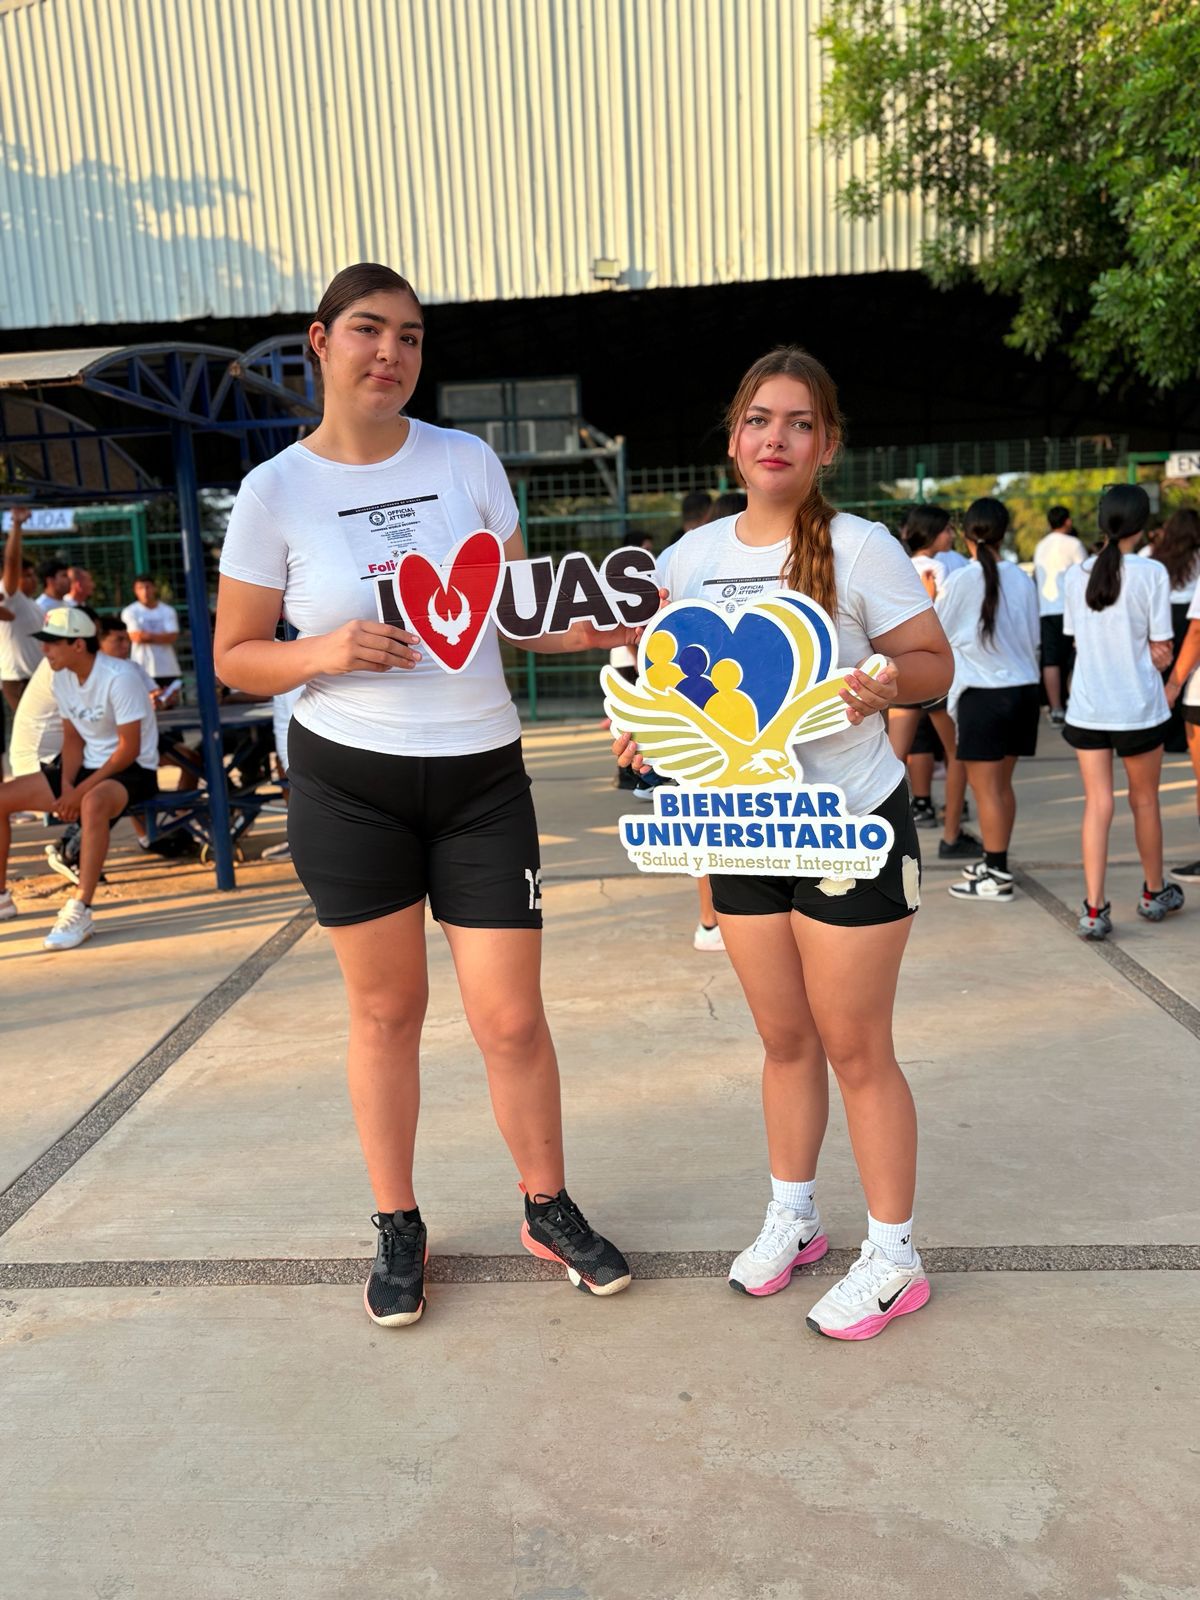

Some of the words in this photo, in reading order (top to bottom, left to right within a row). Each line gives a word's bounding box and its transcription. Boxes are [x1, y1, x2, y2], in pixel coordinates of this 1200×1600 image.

[388, 508, 415, 516] OFFICIAL
[389, 512, 416, 521] ATTEMPT
[368, 560, 398, 573] Foli
[497, 550, 660, 637] UAS
[660, 792, 841, 818] BIENESTAR
[625, 823, 888, 850] UNIVERSITARIO
[694, 854, 704, 871] y
[707, 853, 792, 871] Bienestar
